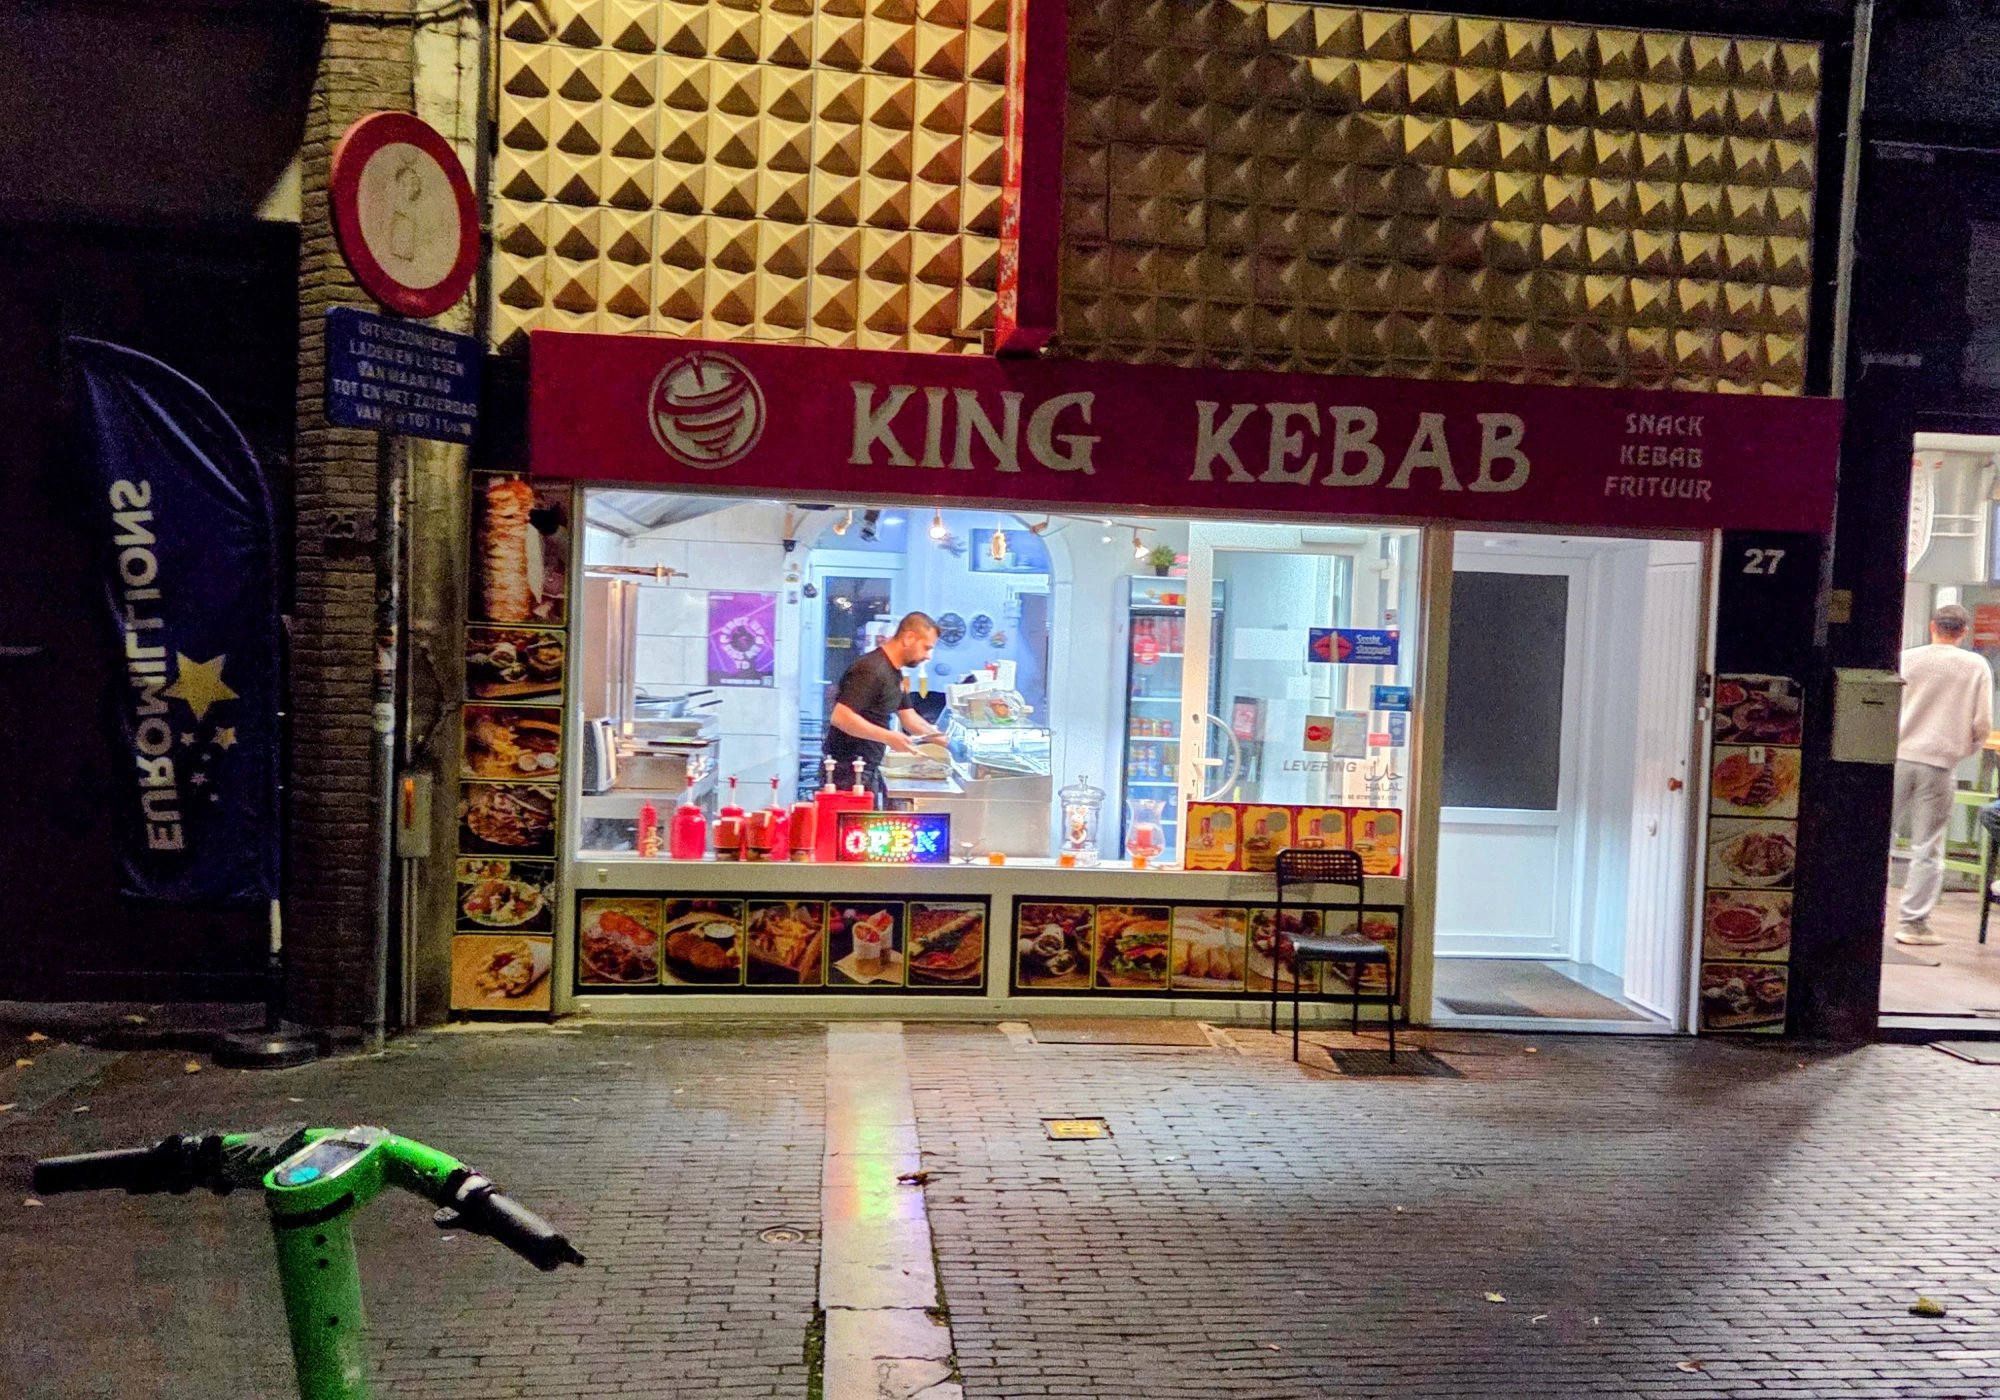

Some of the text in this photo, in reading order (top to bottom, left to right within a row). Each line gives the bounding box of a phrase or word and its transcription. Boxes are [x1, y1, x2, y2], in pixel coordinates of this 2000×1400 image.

[848, 381, 1531, 492] KING KEBAB
[1626, 412, 1705, 438] SNACK
[1620, 444, 1704, 469] KEBAB
[1604, 475, 1713, 502] FRITUUR
[1744, 548, 1786, 575] 27
[1282, 760, 1358, 774] LEVERING
[1365, 782, 1403, 793] HALAL
[845, 830, 941, 854] OPEN
